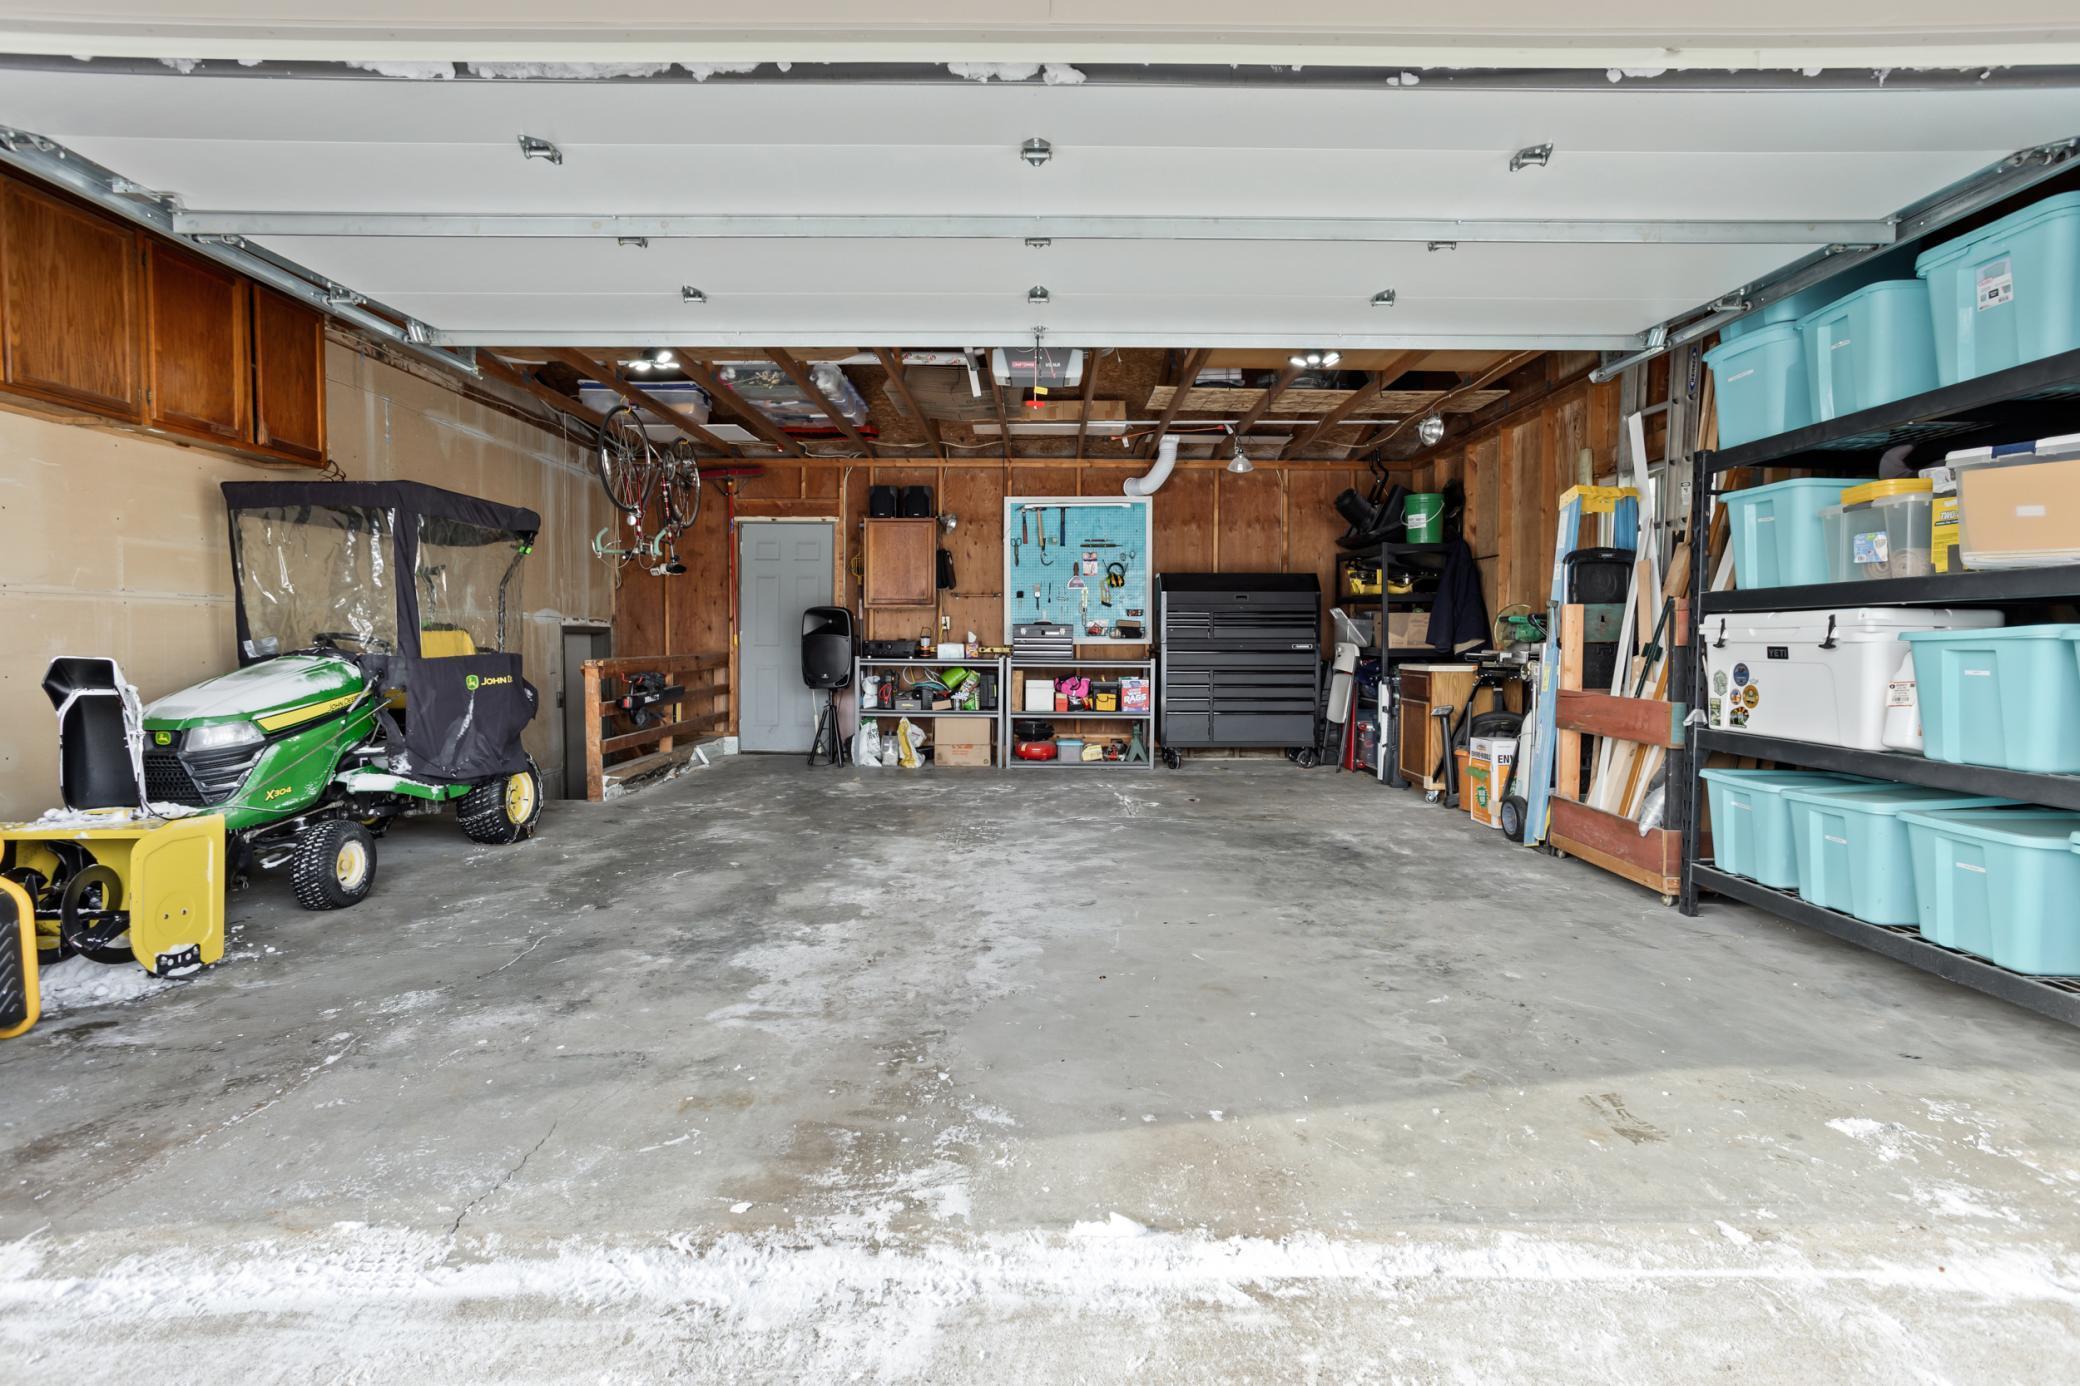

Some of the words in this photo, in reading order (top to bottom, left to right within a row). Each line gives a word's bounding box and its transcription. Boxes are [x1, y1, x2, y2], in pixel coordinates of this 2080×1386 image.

[1768, 648, 1787, 657] YETI
[481, 676, 507, 686] JOHN
[265, 786, 292, 801] X304
